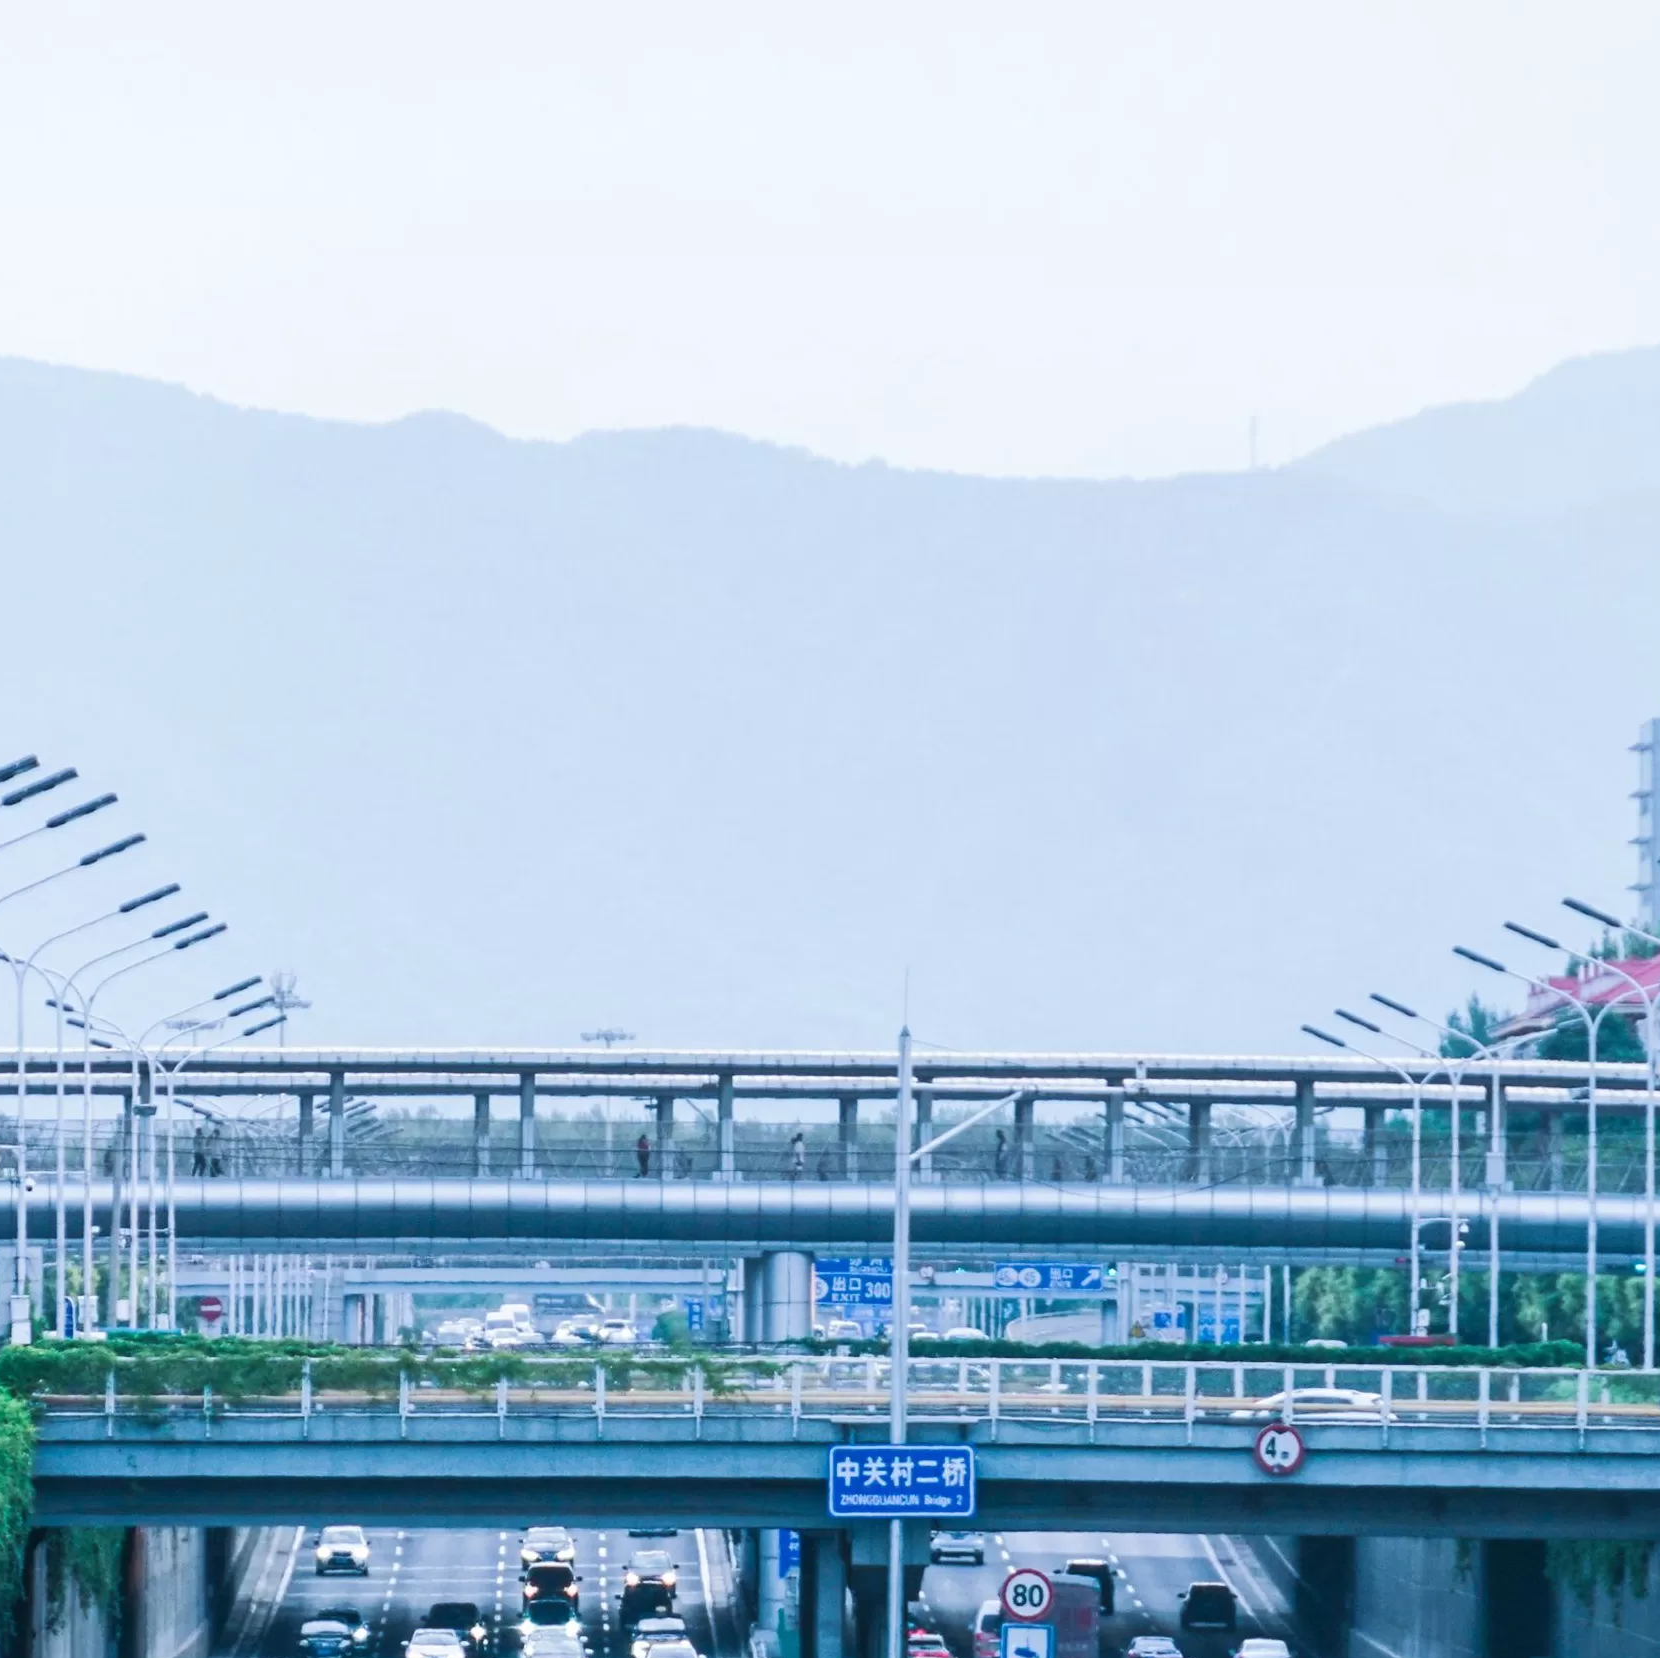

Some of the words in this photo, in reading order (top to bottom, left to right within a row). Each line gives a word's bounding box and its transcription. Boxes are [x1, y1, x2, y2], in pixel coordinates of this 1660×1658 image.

[831, 1293, 861, 1302] EXIT
[832, 1276, 862, 1292] 出口
[864, 1281, 892, 1299] 300
[836, 1456, 968, 1488] 中关村二桥
[840, 1494, 920, 1507] ZHONGGUANCUN
[924, 1494, 952, 1508] Bridge
[956, 1495, 963, 1507] 2
[1012, 1583, 1044, 1608] 80
